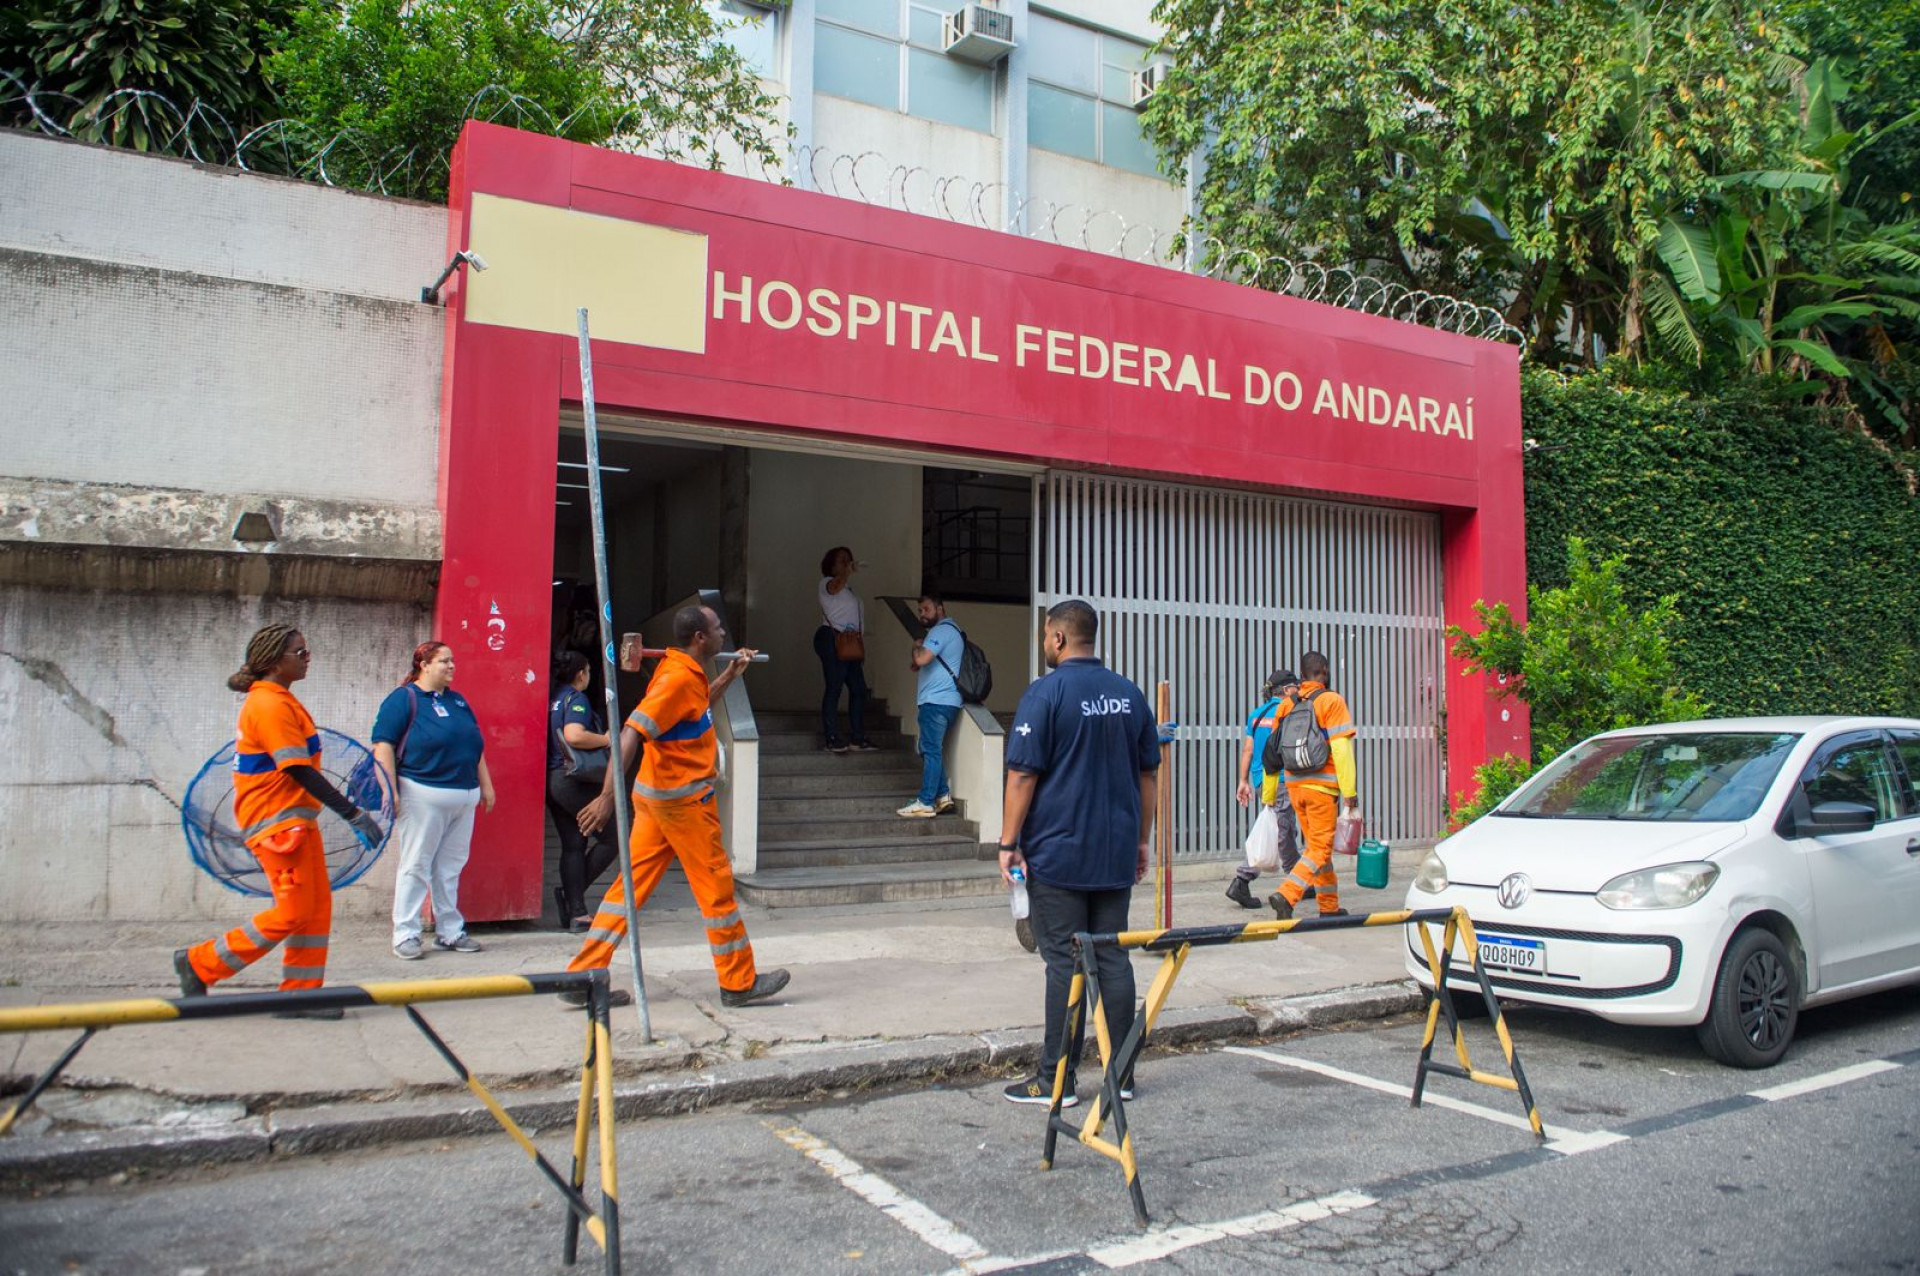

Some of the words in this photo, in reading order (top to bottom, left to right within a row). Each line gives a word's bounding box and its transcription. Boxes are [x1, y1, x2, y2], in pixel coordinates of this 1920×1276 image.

[713, 270, 999, 363] HOSPITAL
[1016, 323, 1231, 400] FEDERAL
[1244, 364, 1303, 411] DO
[1312, 378, 1474, 441] ANDARAÍ
[1080, 694, 1131, 717] SAÚDE
